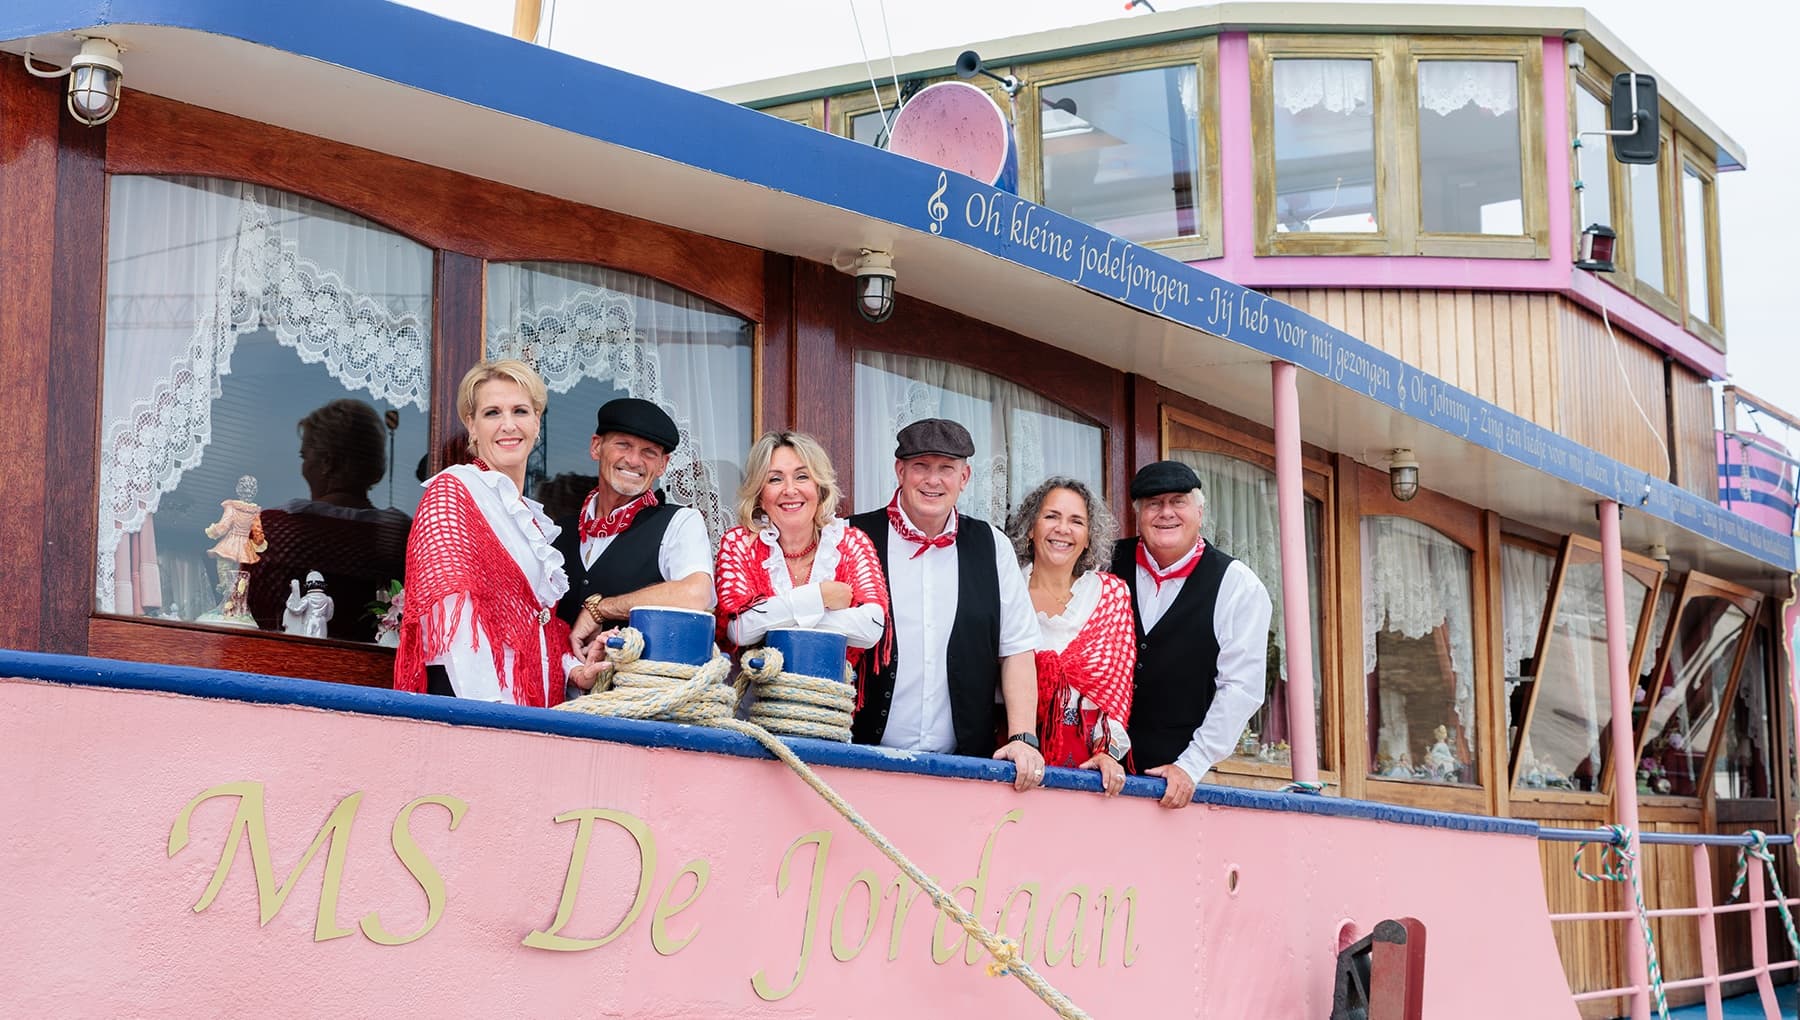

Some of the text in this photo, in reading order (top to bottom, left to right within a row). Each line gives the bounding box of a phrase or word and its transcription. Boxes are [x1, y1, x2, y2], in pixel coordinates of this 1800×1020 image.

[965, 192, 1002, 236] Oh
[1009, 200, 1073, 262] kleine
[1072, 234, 1190, 313] jodeljongen
[1208, 287, 1234, 337] Jij
[1239, 290, 1271, 334] heb
[1273, 317, 1308, 349] voor
[1312, 331, 1334, 376] mij
[1336, 346, 1391, 397] gezongen
[1411, 372, 1428, 406] Oh
[1430, 382, 1471, 437] Johnny
[1480, 407, 1504, 453] Zing
[167, 780, 1142, 1001] MS De Jordaan
